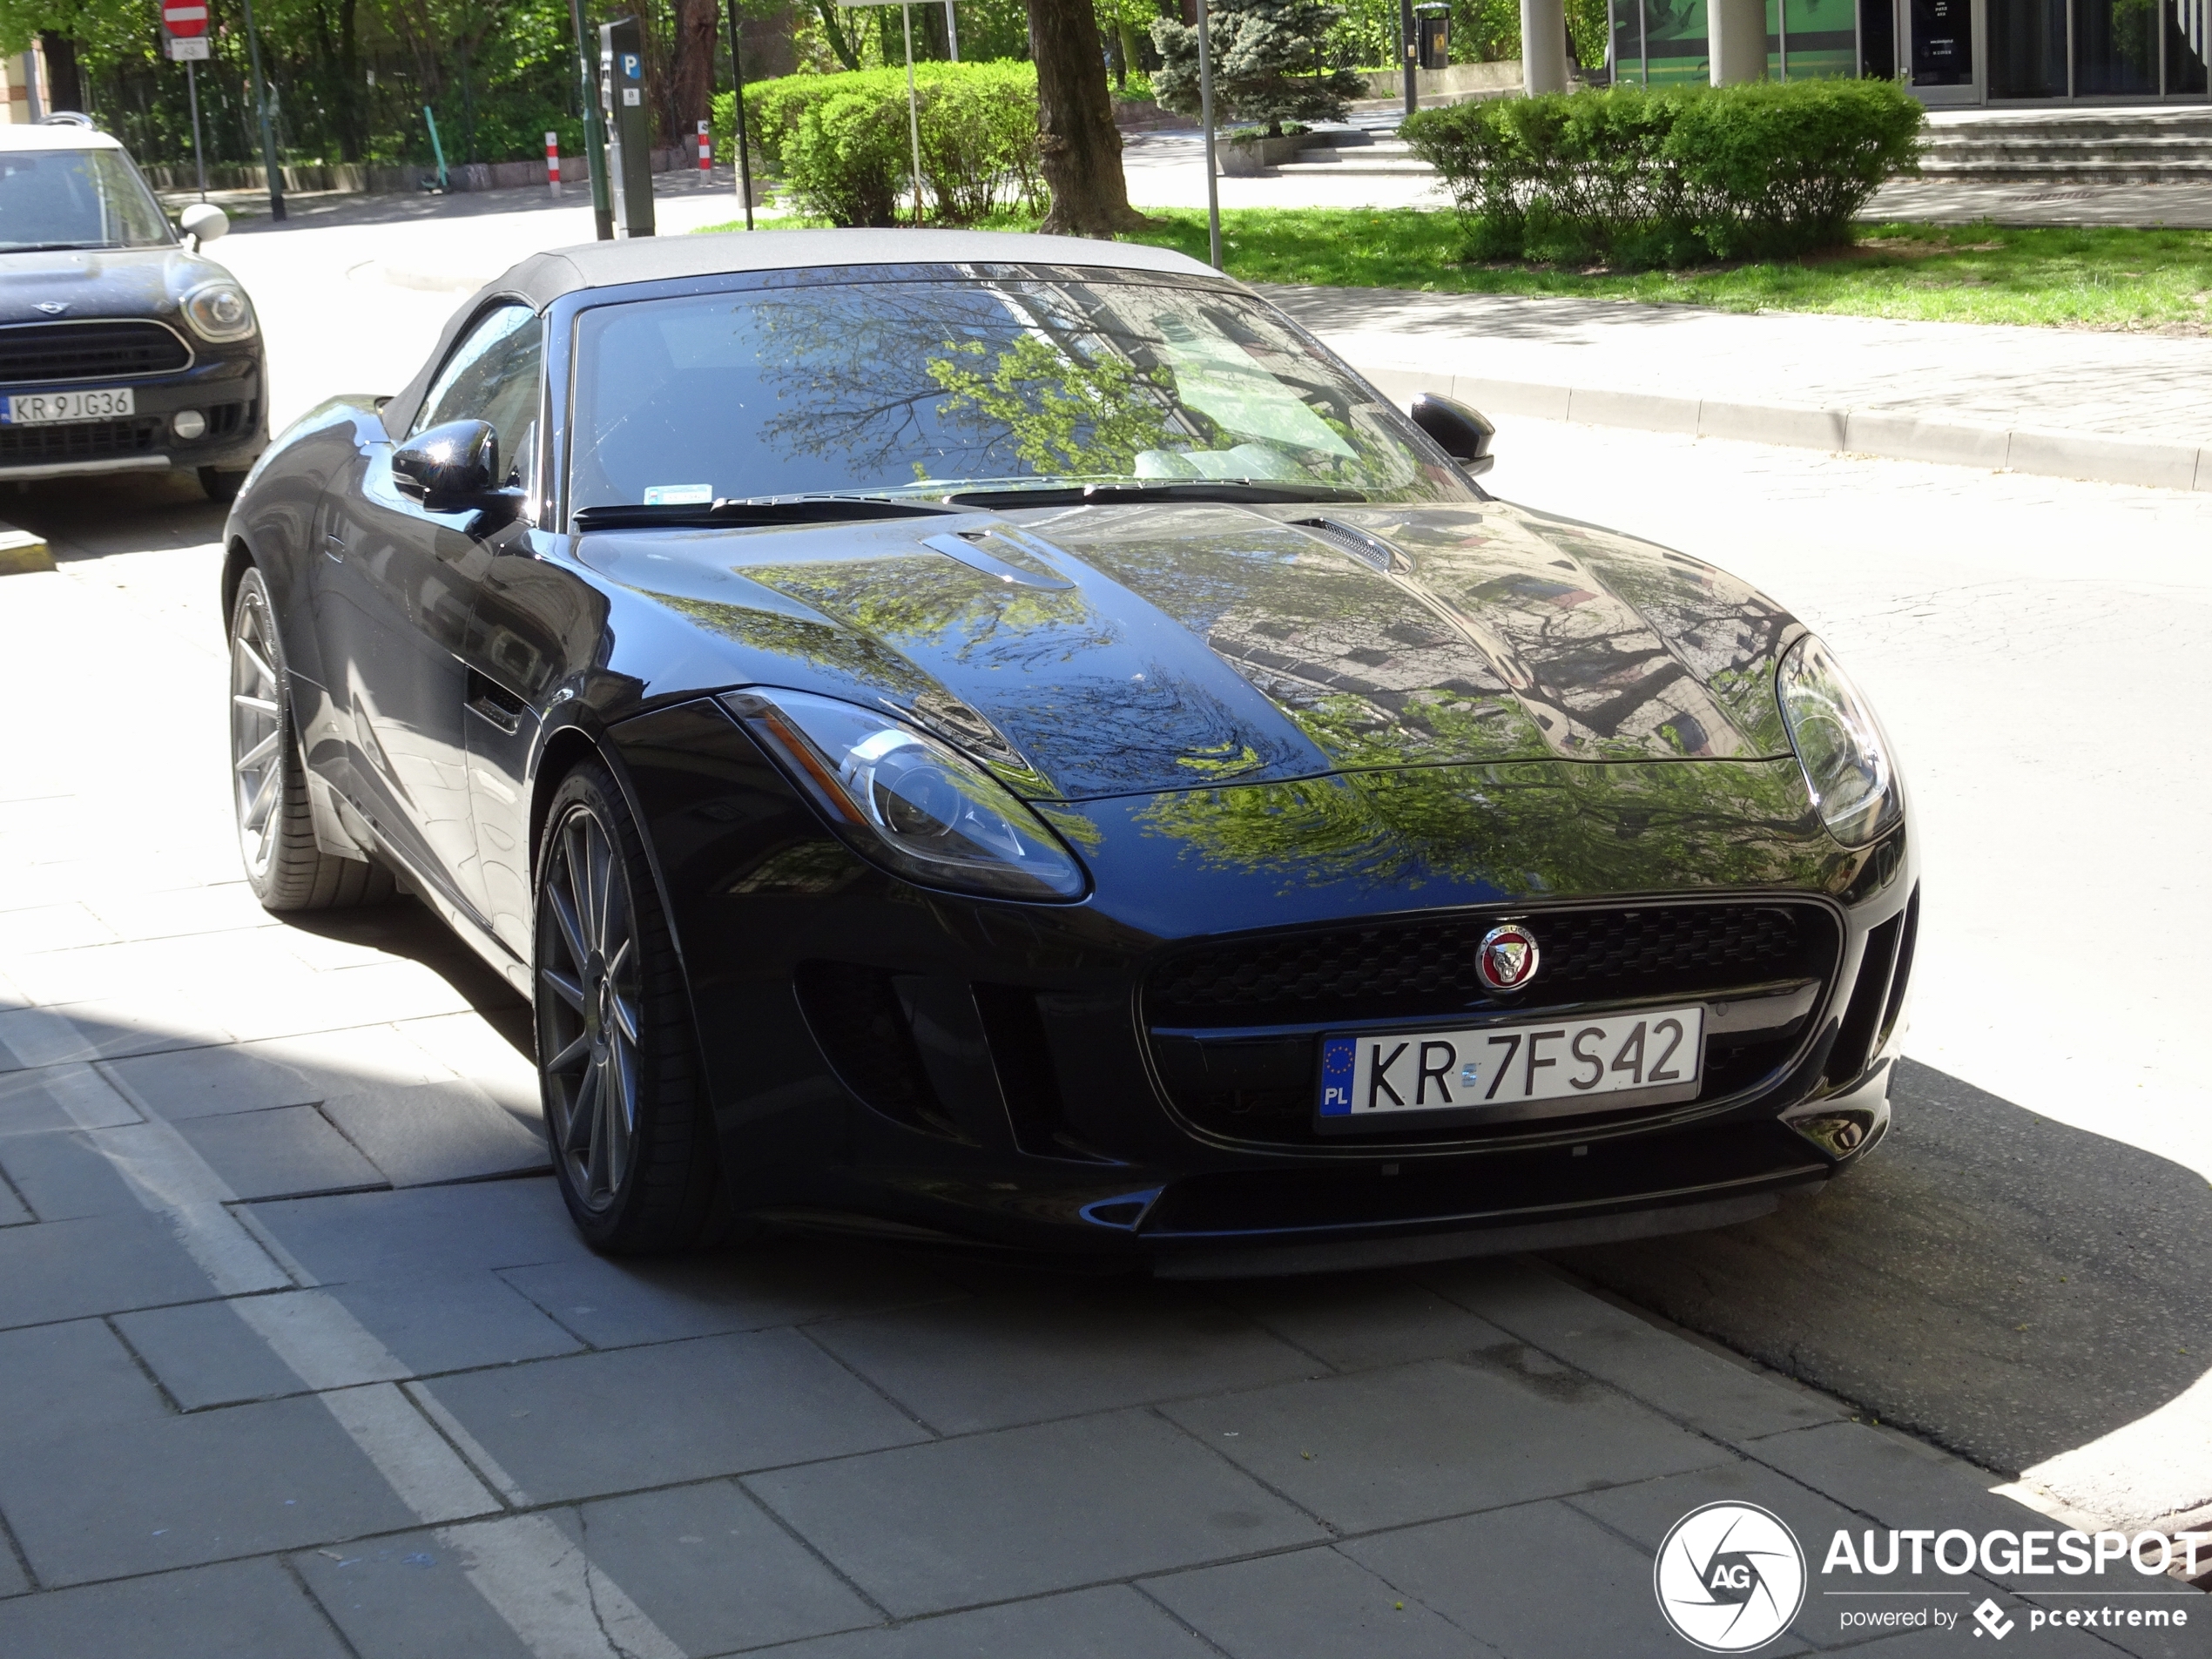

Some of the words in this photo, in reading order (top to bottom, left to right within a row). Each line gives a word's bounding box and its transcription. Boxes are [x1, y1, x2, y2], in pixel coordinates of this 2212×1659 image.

[624, 55, 637, 75] P
[15, 397, 46, 421] KR
[55, 391, 127, 418] 9JG36
[1368, 1040, 1457, 1108] KR
[1485, 1018, 1684, 1100] 7FS42
[1325, 1088, 1348, 1106] PL
